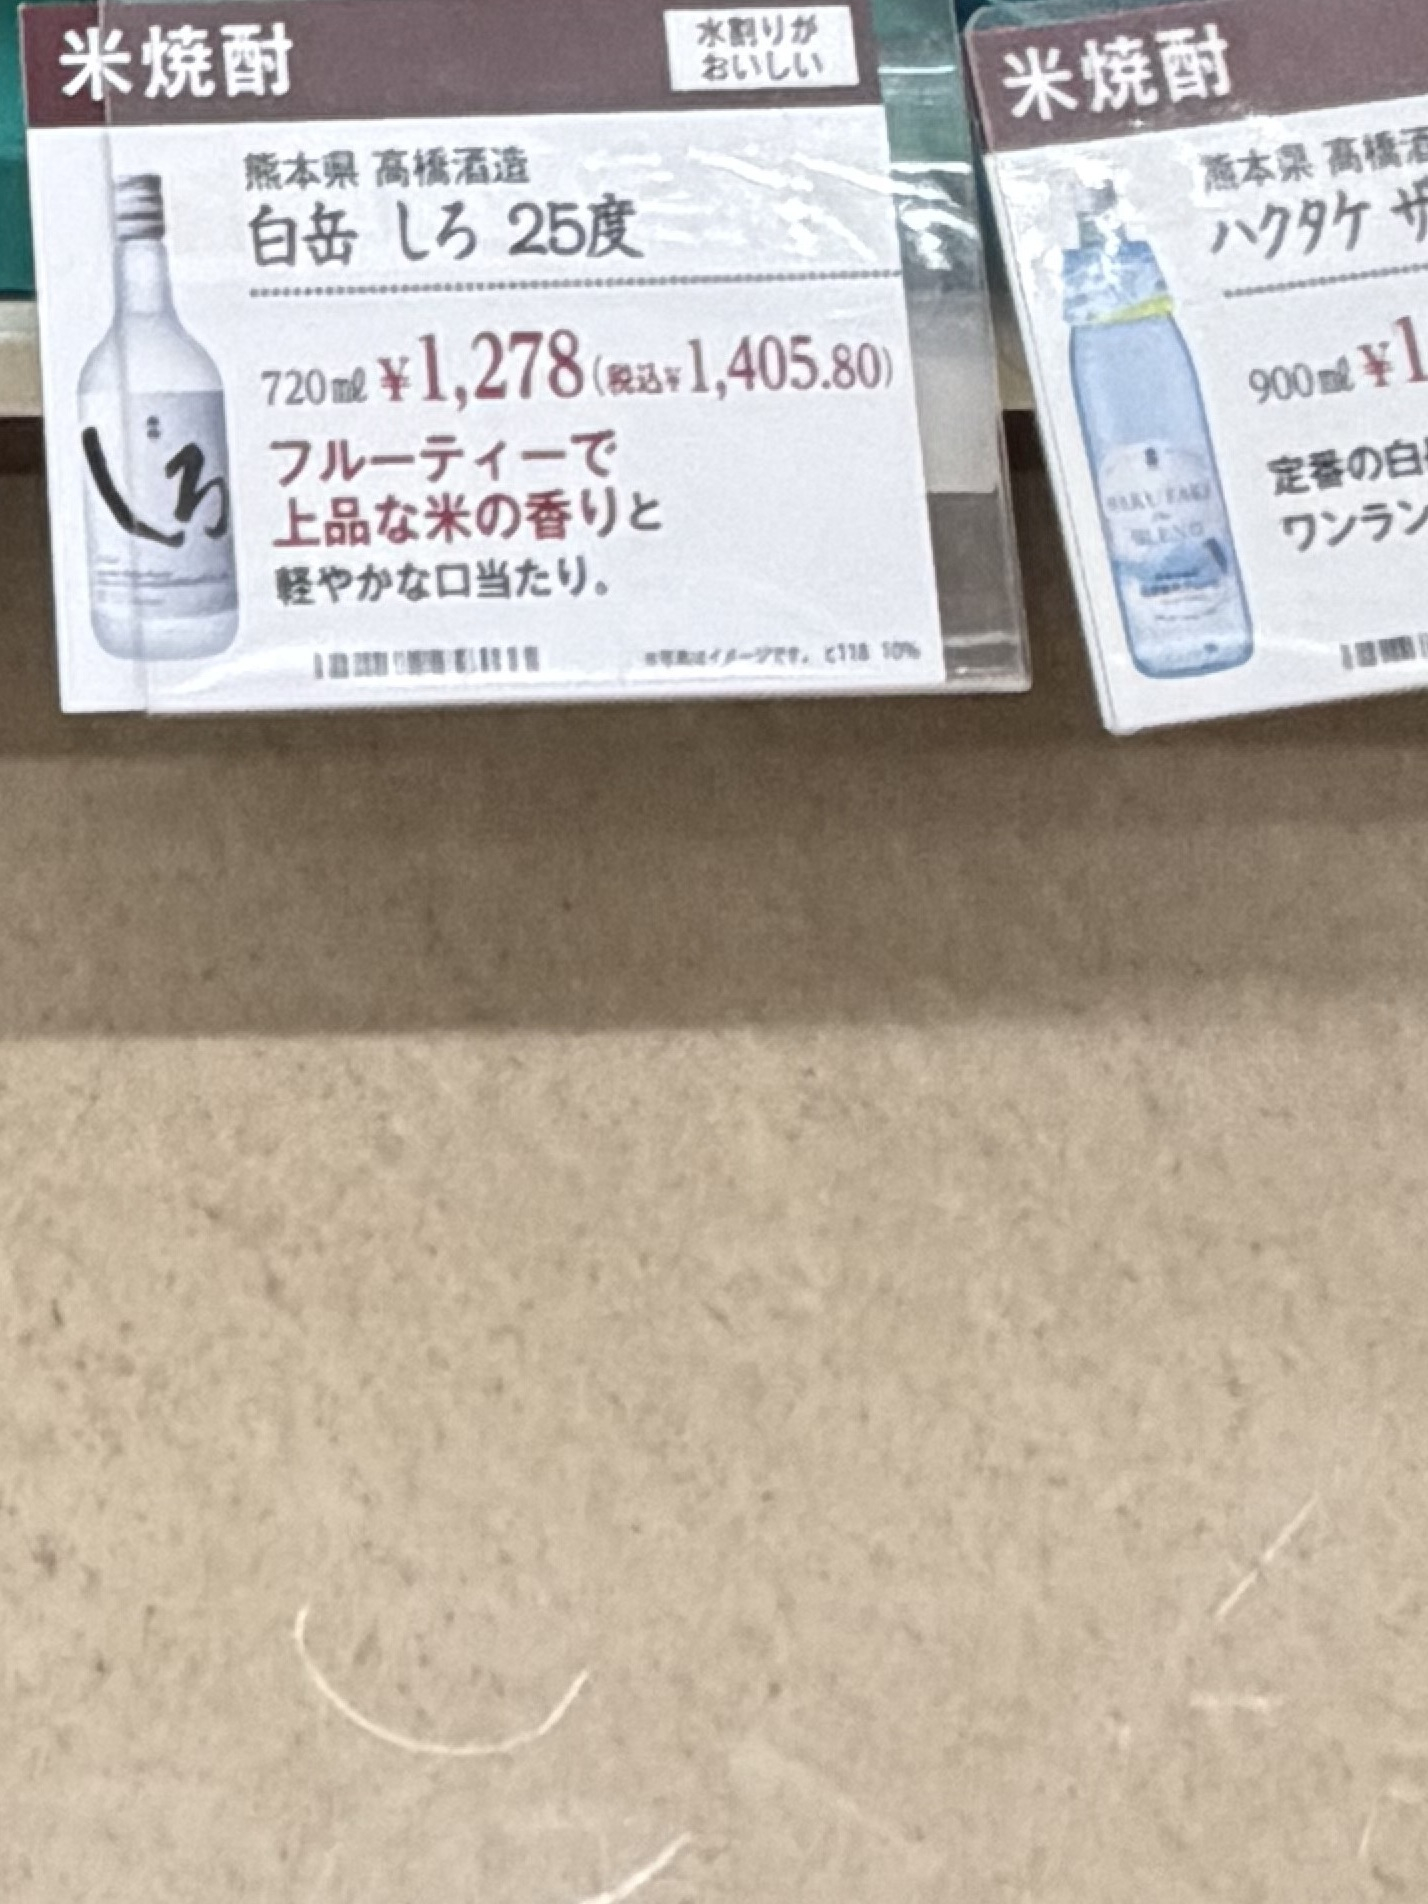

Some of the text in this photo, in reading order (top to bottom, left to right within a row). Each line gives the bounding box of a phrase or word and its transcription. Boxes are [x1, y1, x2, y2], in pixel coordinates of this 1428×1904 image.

[57, 11, 820, 103] 米焼酎 水割りが
[700, 49, 826, 84] おいしい
[1001, 20, 1233, 123] 米焼酎
[242, 143, 531, 192] 熊本県 高橋酒造
[247, 191, 646, 268] 白岳 しろ 25度
[1209, 189, 1372, 261] ハクタケ
[268, 428, 619, 487] フルーティーで
[1265, 436, 1428, 497] 定番の白
[272, 491, 665, 550] 上品な米の香りと
[274, 561, 611, 607] 軽やかな口当たり。
